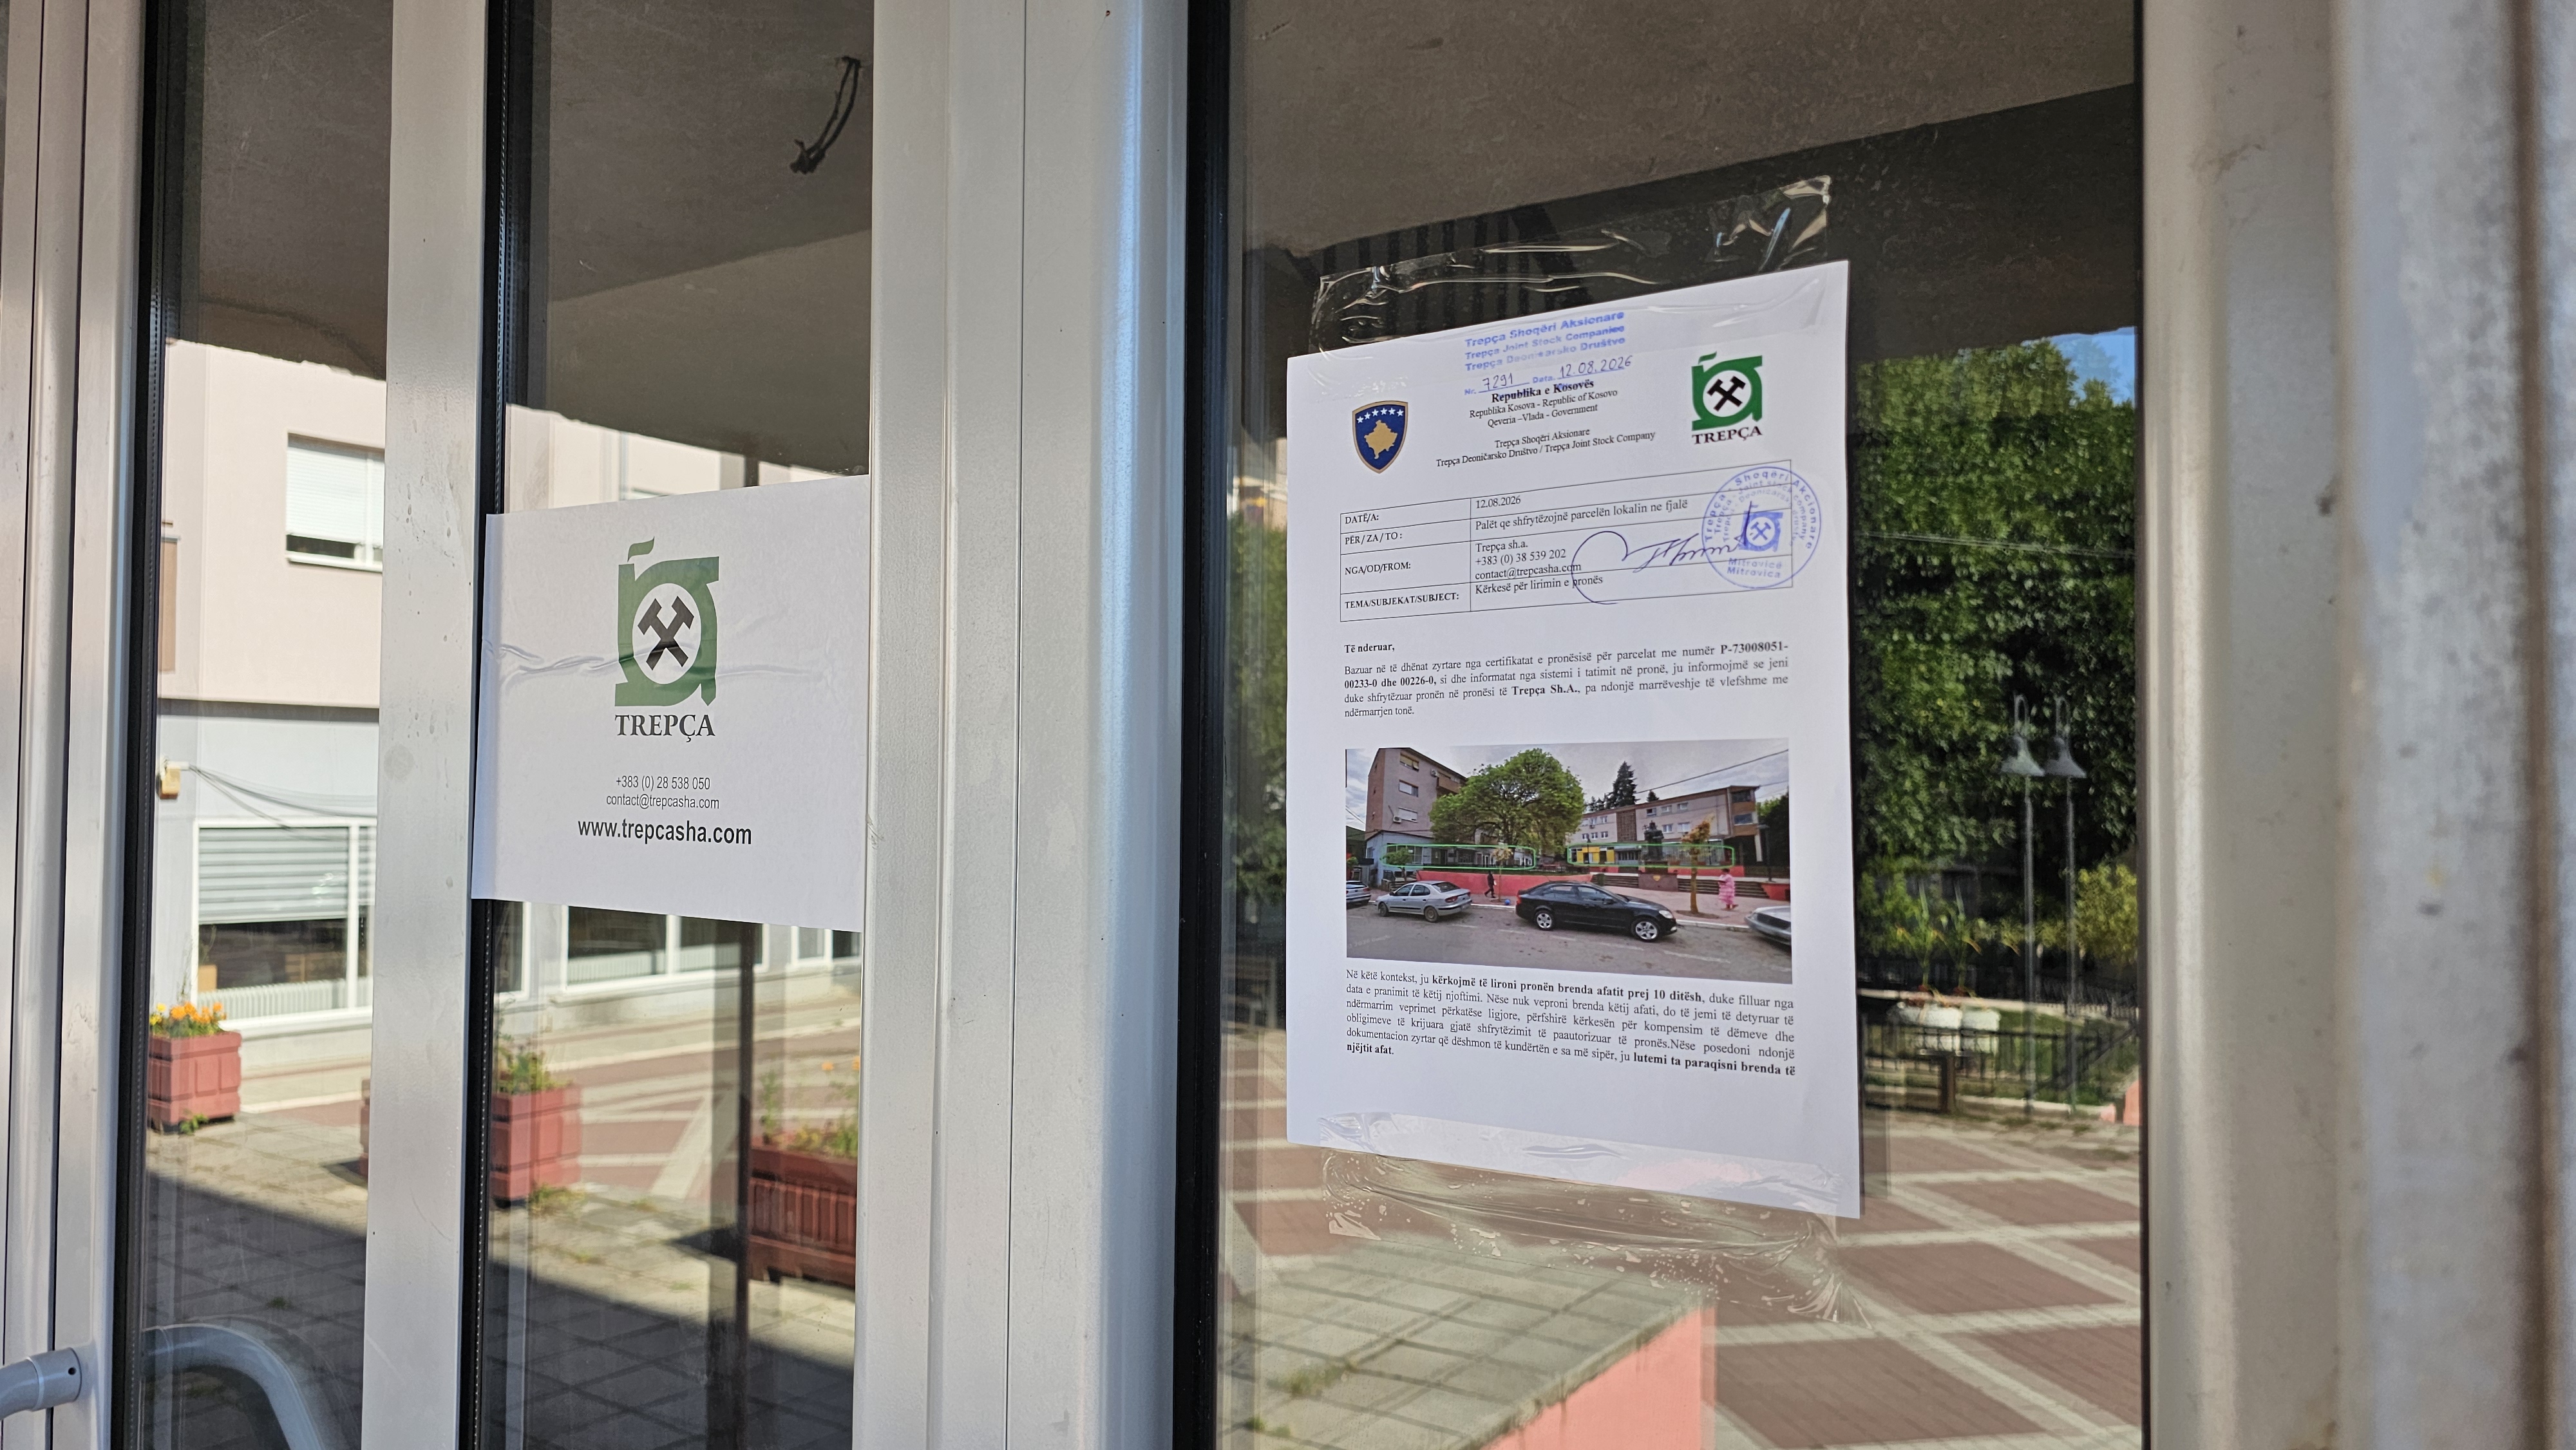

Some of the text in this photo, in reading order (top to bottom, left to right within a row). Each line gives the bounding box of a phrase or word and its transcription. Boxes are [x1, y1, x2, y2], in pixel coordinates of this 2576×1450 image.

[1464, 334, 1506, 348] Trepça
[1510, 322, 1556, 339] Shoqëri
[1464, 348, 1500, 359] Trepça
[1503, 341, 1529, 352] Joint
[1531, 335, 1562, 347] Stock
[1464, 359, 1503, 372] Trepça
[1580, 337, 1625, 351] Društvo
[1482, 372, 1513, 390] 7291
[1560, 355, 1633, 379] 12.08.2026
[1492, 387, 1542, 403] Republika
[1553, 379, 1595, 393] Kosovës
[1469, 405, 1506, 419] Republika
[1507, 402, 1535, 413] Kosova
[1542, 394, 1576, 408] Republic
[1577, 391, 1586, 402] of
[1587, 390, 1618, 400] Kosovo
[1487, 415, 1517, 429] Qeveria
[1517, 411, 1544, 422] –Vlada
[1551, 404, 1598, 418] Government
[1493, 429, 1590, 449] Trepça Shoqëri Aksionare
[1692, 426, 1762, 445] TREPÇA
[1435, 458, 1461, 468] Trepça
[1461, 450, 1507, 464] Deoničarsko
[1508, 447, 1538, 458] Društvo
[1545, 443, 1570, 453] Trepça
[1571, 439, 1591, 449] Joint
[1592, 435, 1615, 446] Stock
[1616, 431, 1656, 443] Company
[1475, 495, 1521, 509] 12.08.2026
[1345, 514, 1379, 524] DATË/A:
[1475, 499, 1688, 531] Palët qe shfrytëzojnë parcelën lokalin ne fjalë
[1475, 539, 1528, 554] Trepça sh.a.
[1475, 548, 1566, 566] +383 (0) 38 539 202
[1345, 561, 1411, 575] NGA/OD/FROM:
[1475, 564, 1582, 579] contact@trepcasha.com
[1475, 582, 1511, 595] Kërkesë
[1513, 581, 1528, 594] për
[1530, 578, 1562, 590] lirimin
[1571, 575, 1603, 589] pronës
[1345, 592, 1459, 609] TEMA/SUBJEKAT/SUBJECT:
[1343, 643, 1395, 654] Të nderuar,
[1344, 666, 1373, 675] Bazuar
[1376, 664, 1386, 673] në
[1390, 663, 1397, 673] të
[1400, 662, 1428, 672] dhënat
[1432, 661, 1461, 672] zyrtare
[1465, 661, 1481, 670] nga
[1485, 655, 1533, 667] certifikatat
[1547, 652, 1592, 666] pronësisë
[1596, 651, 1612, 664] për
[1616, 648, 1656, 663] parcelat
[1681, 646, 1715, 657] numër
[1720, 641, 1788, 655] P-73008051-
[1344, 656, 1788, 689] 00233-0 dhe 00226-0, si dhe informatat nga sistemi i tatimit në pronë, ju informojmë se jeni
[1344, 706, 1414, 718] ndërmarrjen tonë.
[614, 714, 716, 743] TREPÇA
[616, 775, 710, 792] +383 (0) 28 538 050
[606, 793, 719, 810] contact@trepcasha.com
[578, 818, 752, 845] www.trepcasha.com
[1346, 968, 1794, 1011] Në këtë kontekst, ju kërkojmë të lironi pronën brenda afatit prej 10 ditësh, duke filluar nga
[1346, 998, 1795, 1042] ndërmarrim veprimet përkatëse ligjore, përfshirë kërkesën për kompensim të dëmeve dhe
[1347, 1040, 1394, 1056] njëjtit afat.
